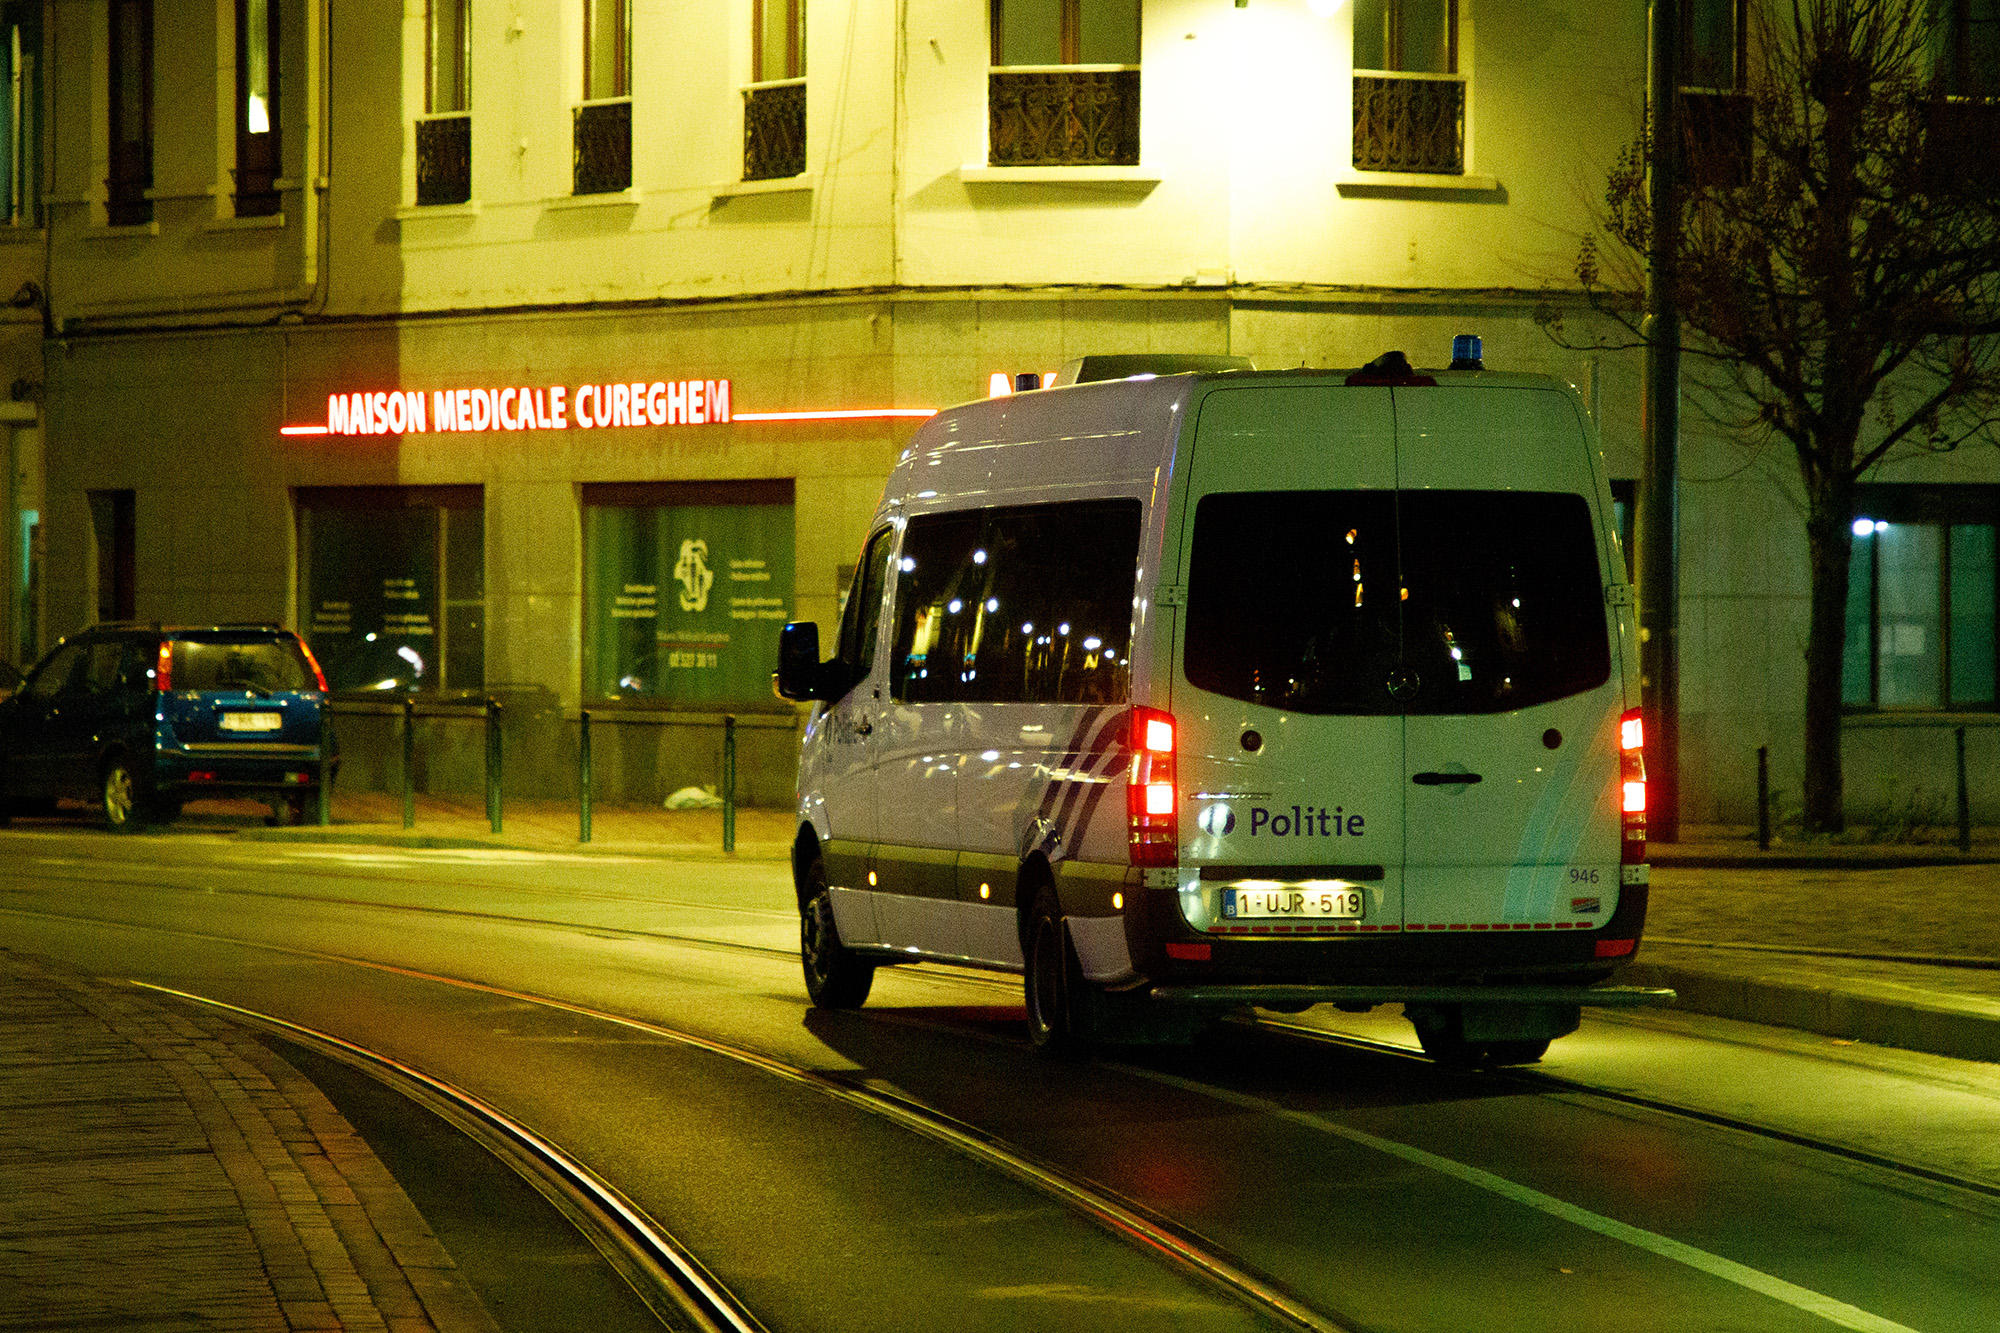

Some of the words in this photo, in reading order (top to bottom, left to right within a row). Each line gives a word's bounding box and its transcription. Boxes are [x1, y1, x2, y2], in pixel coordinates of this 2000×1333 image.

[328, 391, 427, 435] MAISON
[434, 386, 567, 432] MEDICALE
[575, 379, 729, 428] CUREGHEM
[1250, 806, 1366, 837] Politie
[1569, 868, 1600, 884] 946
[1226, 905, 1236, 915] B
